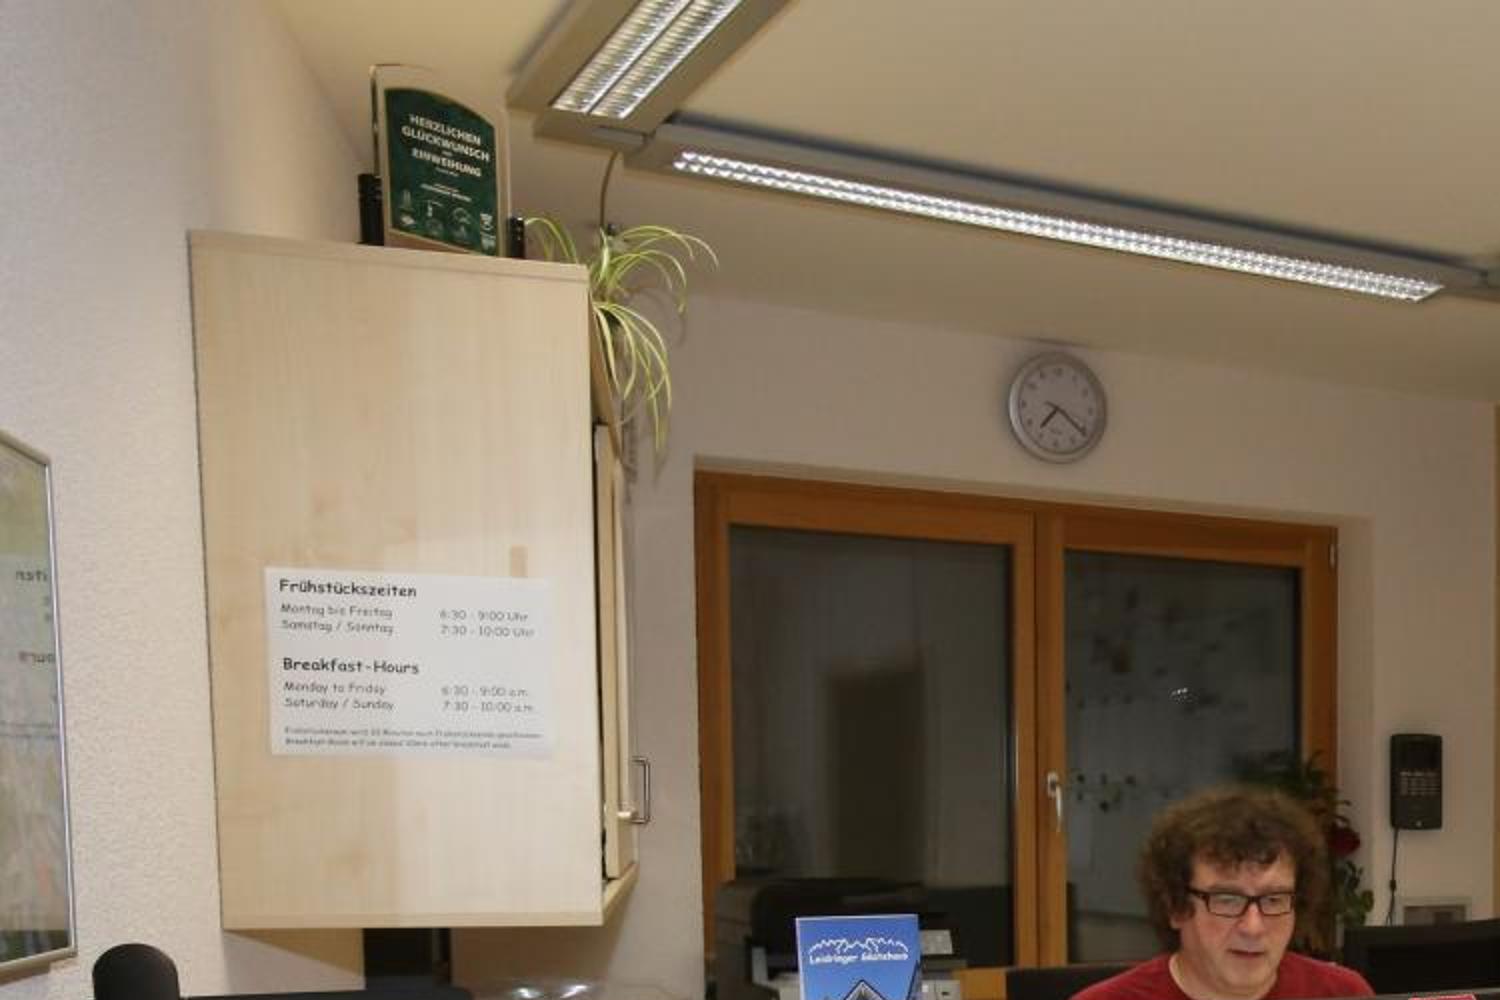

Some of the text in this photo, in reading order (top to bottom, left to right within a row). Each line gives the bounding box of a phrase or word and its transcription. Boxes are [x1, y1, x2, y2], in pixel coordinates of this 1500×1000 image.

[408, 113, 482, 146] HERZLICHEN
[279, 578, 417, 598] Frühstückszeiten
[281, 603, 325, 618] Montag
[349, 605, 393, 620] Freitag
[478, 609, 505, 622] 9:00
[507, 611, 529, 621] Uhr
[281, 620, 333, 633] Samstag
[347, 622, 394, 636] Sonntag
[441, 624, 468, 636] 7:30
[479, 625, 511, 638] 10:00
[513, 627, 535, 638] Uhr
[284, 681, 329, 695] Monday
[333, 683, 345, 693] to
[348, 683, 385, 697] Friday
[284, 698, 339, 711] Saturday
[352, 700, 395, 711] Sunday
[481, 701, 512, 713] 10:00
